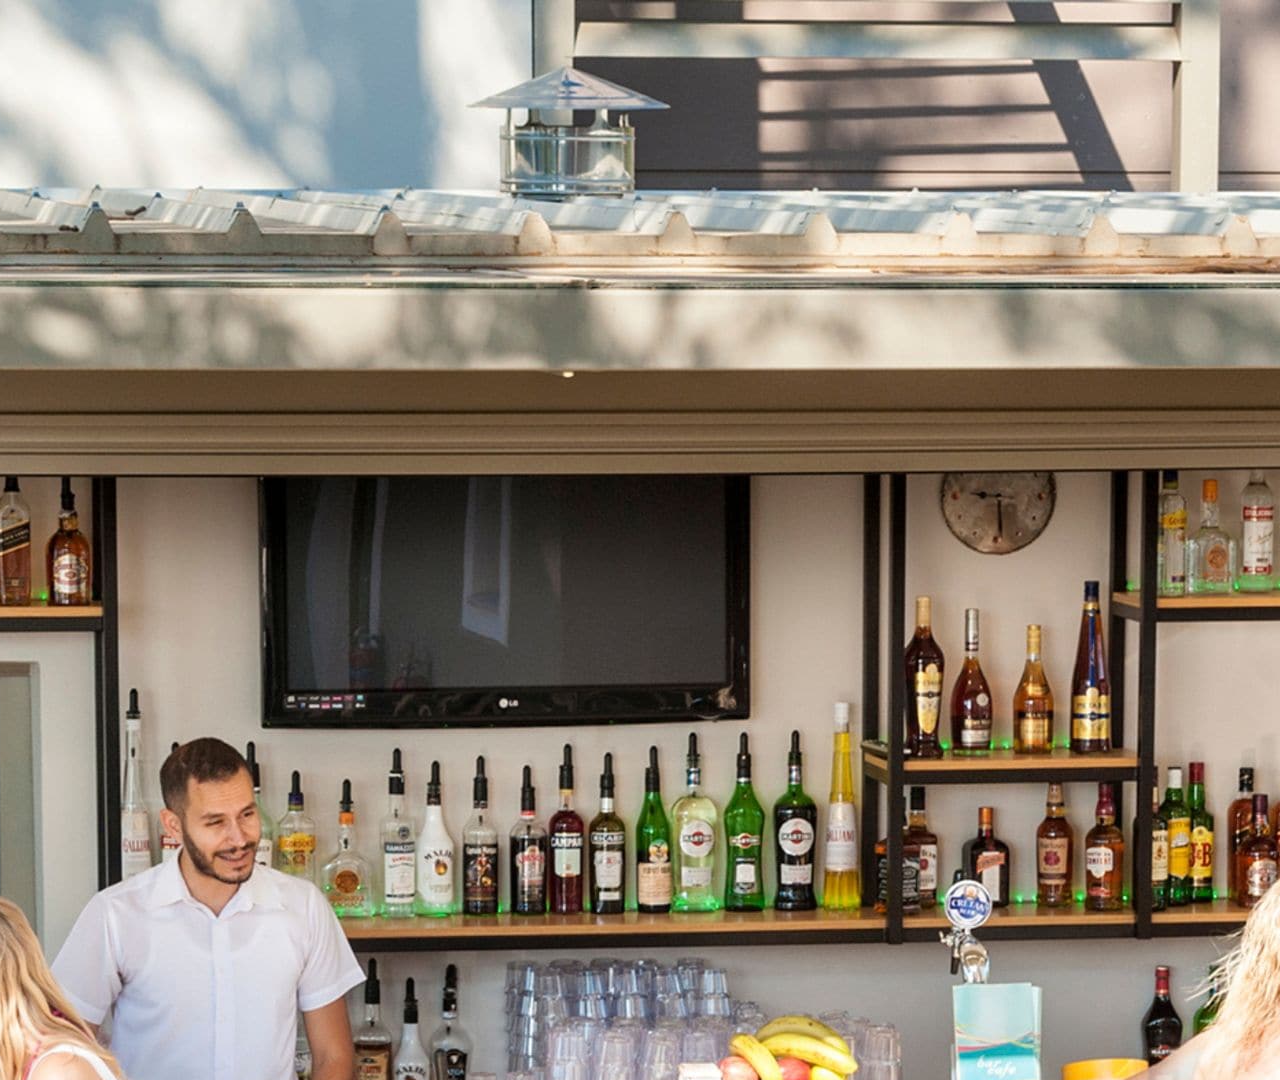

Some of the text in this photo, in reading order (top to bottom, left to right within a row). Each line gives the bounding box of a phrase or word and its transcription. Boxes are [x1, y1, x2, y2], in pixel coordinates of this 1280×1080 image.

[551, 836, 581, 848] CAMPARI
[591, 834, 624, 842] RICARD
[682, 834, 712, 842] MARTINI
[780, 833, 812, 841] MARTINI
[1189, 842, 1212, 868] J&B
[950, 899, 986, 914] CRETAN
[976, 1055, 1002, 1069] bar
[395, 1065, 426, 1077] MALIBU
